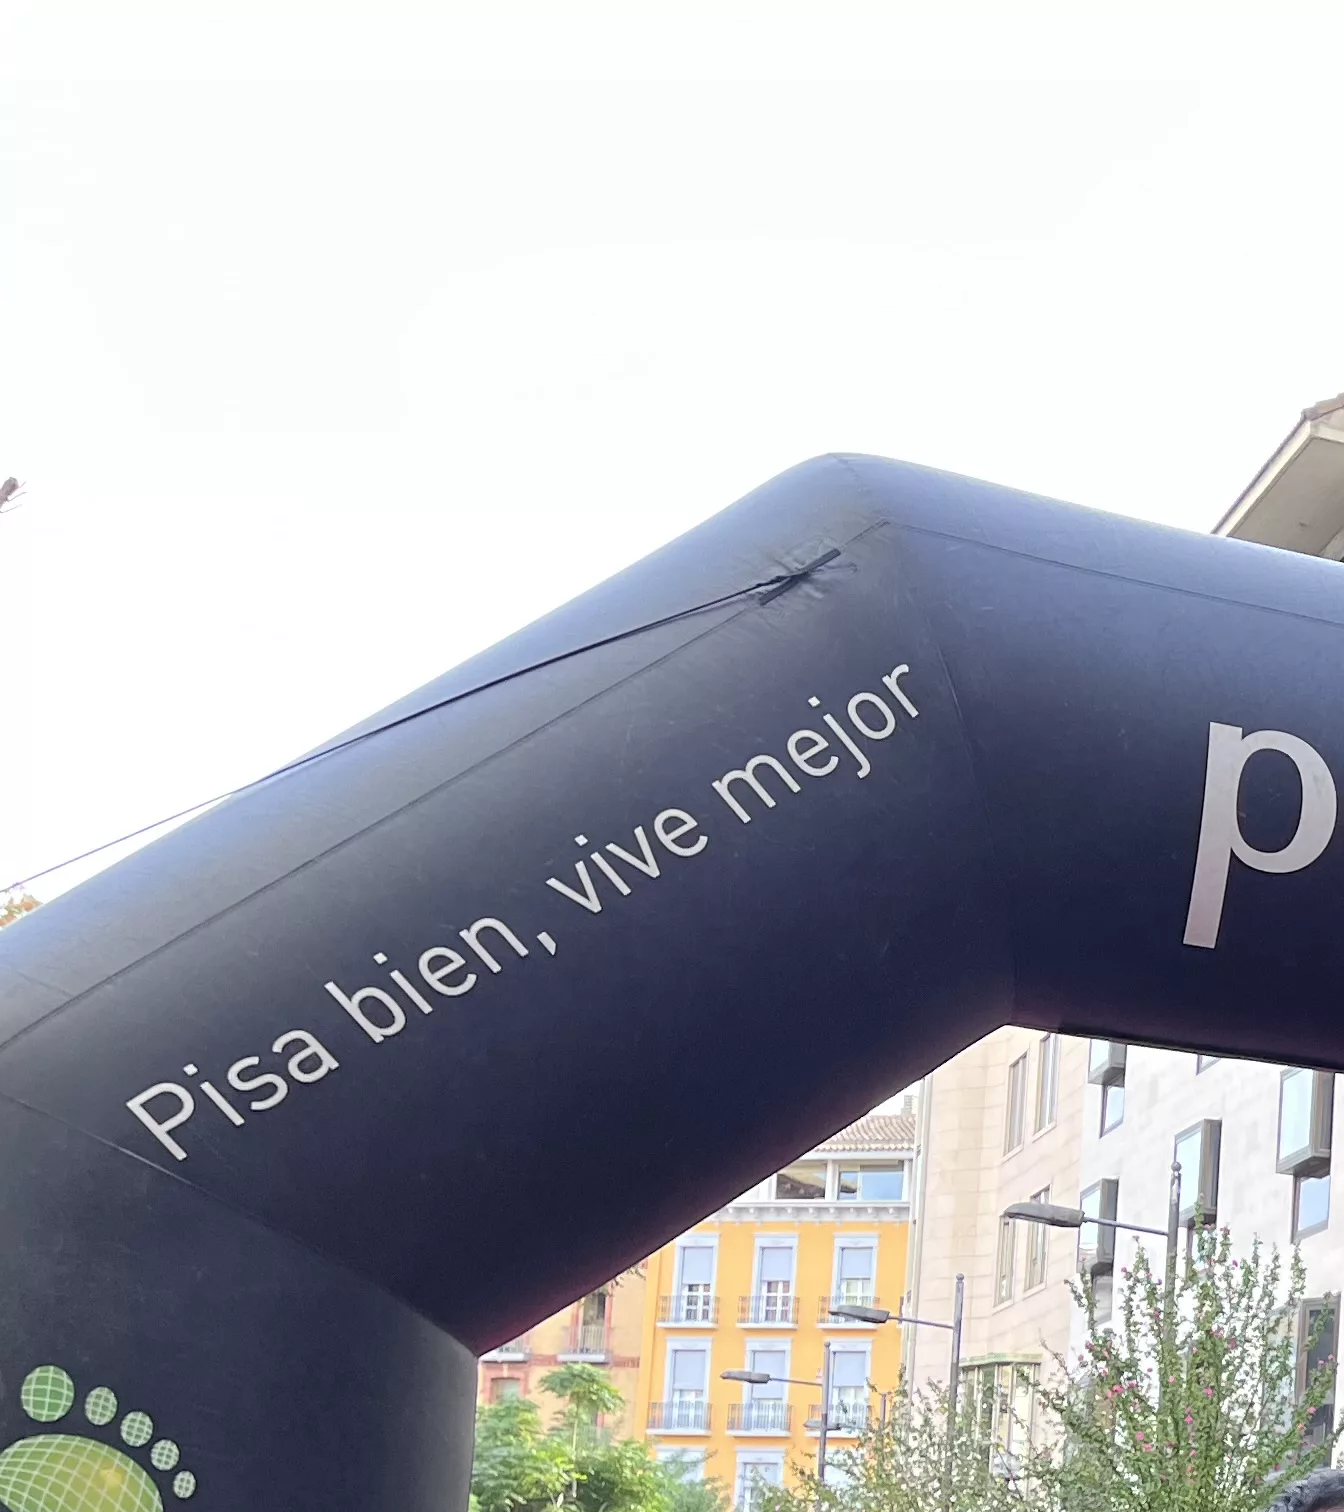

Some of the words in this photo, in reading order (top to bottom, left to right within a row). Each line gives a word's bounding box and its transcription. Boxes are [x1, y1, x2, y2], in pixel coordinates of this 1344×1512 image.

[127, 1030, 340, 1162] Pisa
[324, 916, 559, 1043] bien,
[546, 807, 709, 915] vive
[711, 663, 919, 824] mejor
